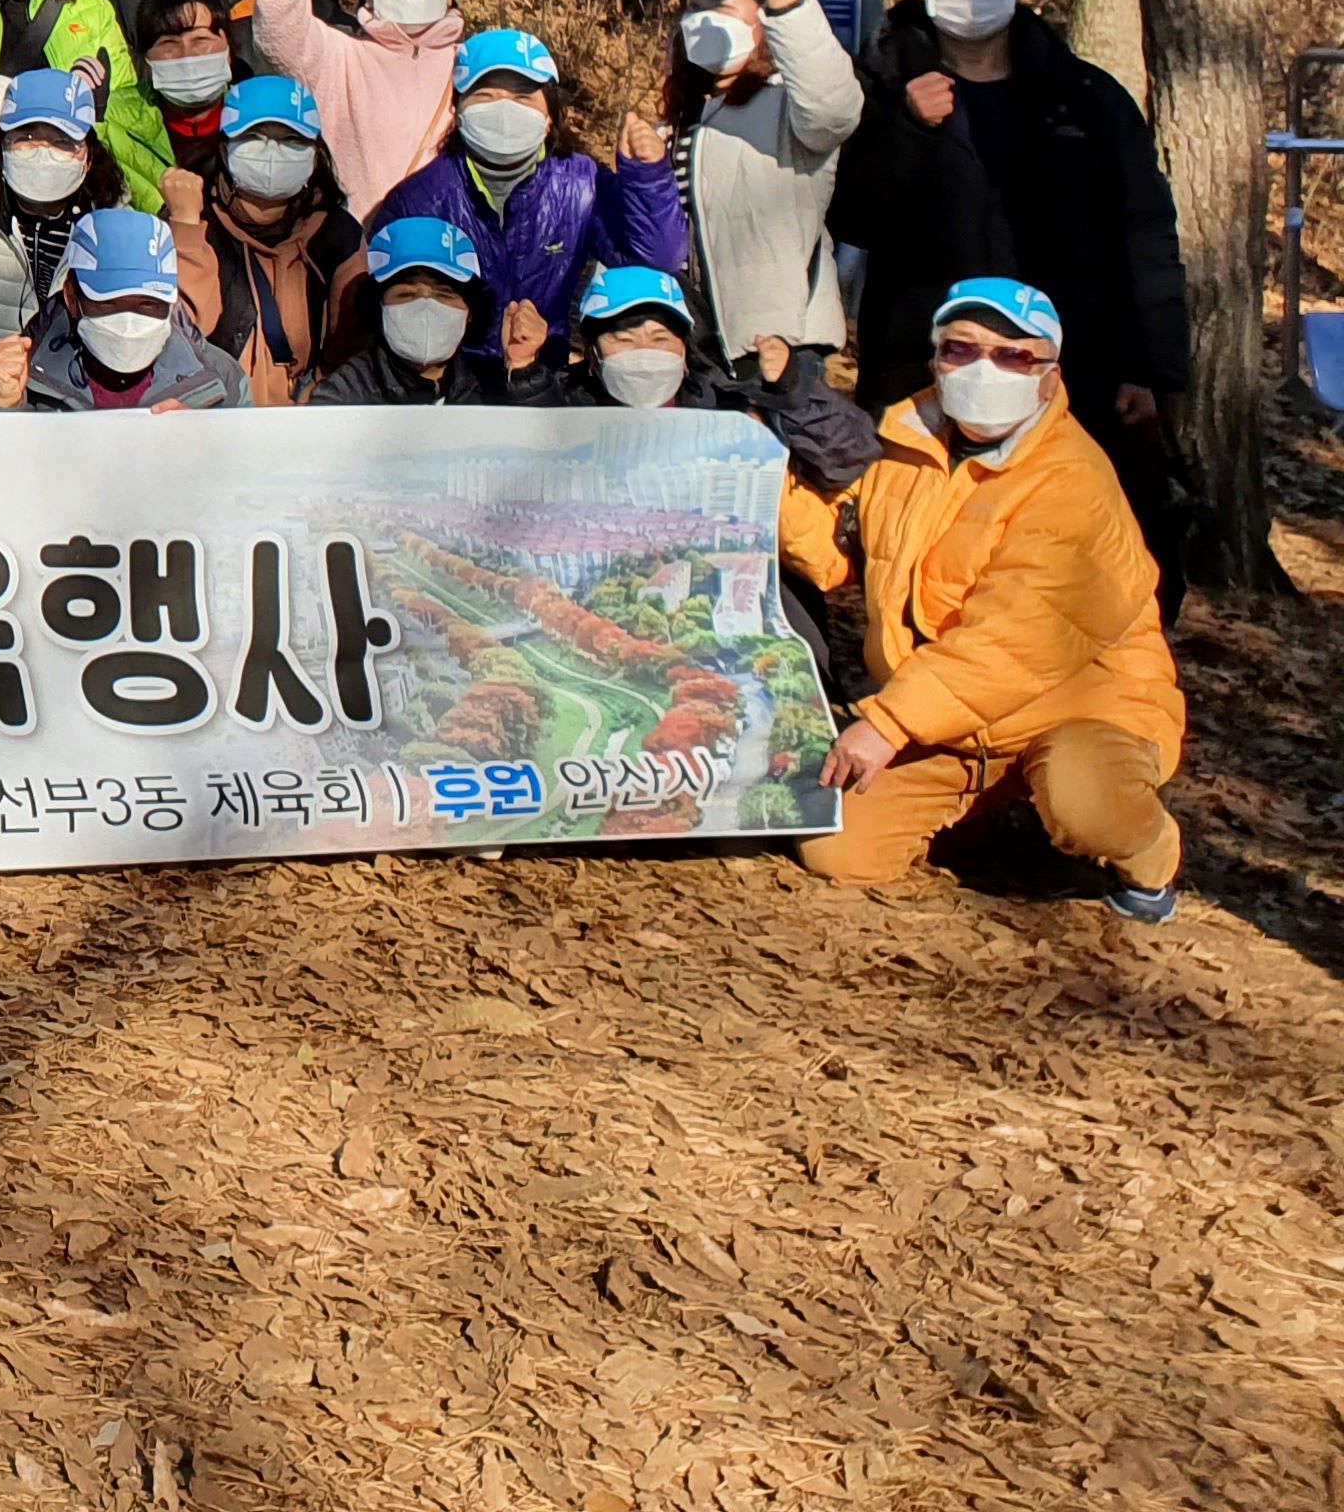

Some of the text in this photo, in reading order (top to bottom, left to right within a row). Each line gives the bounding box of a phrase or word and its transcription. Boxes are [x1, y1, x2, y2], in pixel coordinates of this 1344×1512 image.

[210, 767, 369, 828] 체육회
[427, 763, 543, 819] 후원
[559, 746, 714, 812] 안산시
